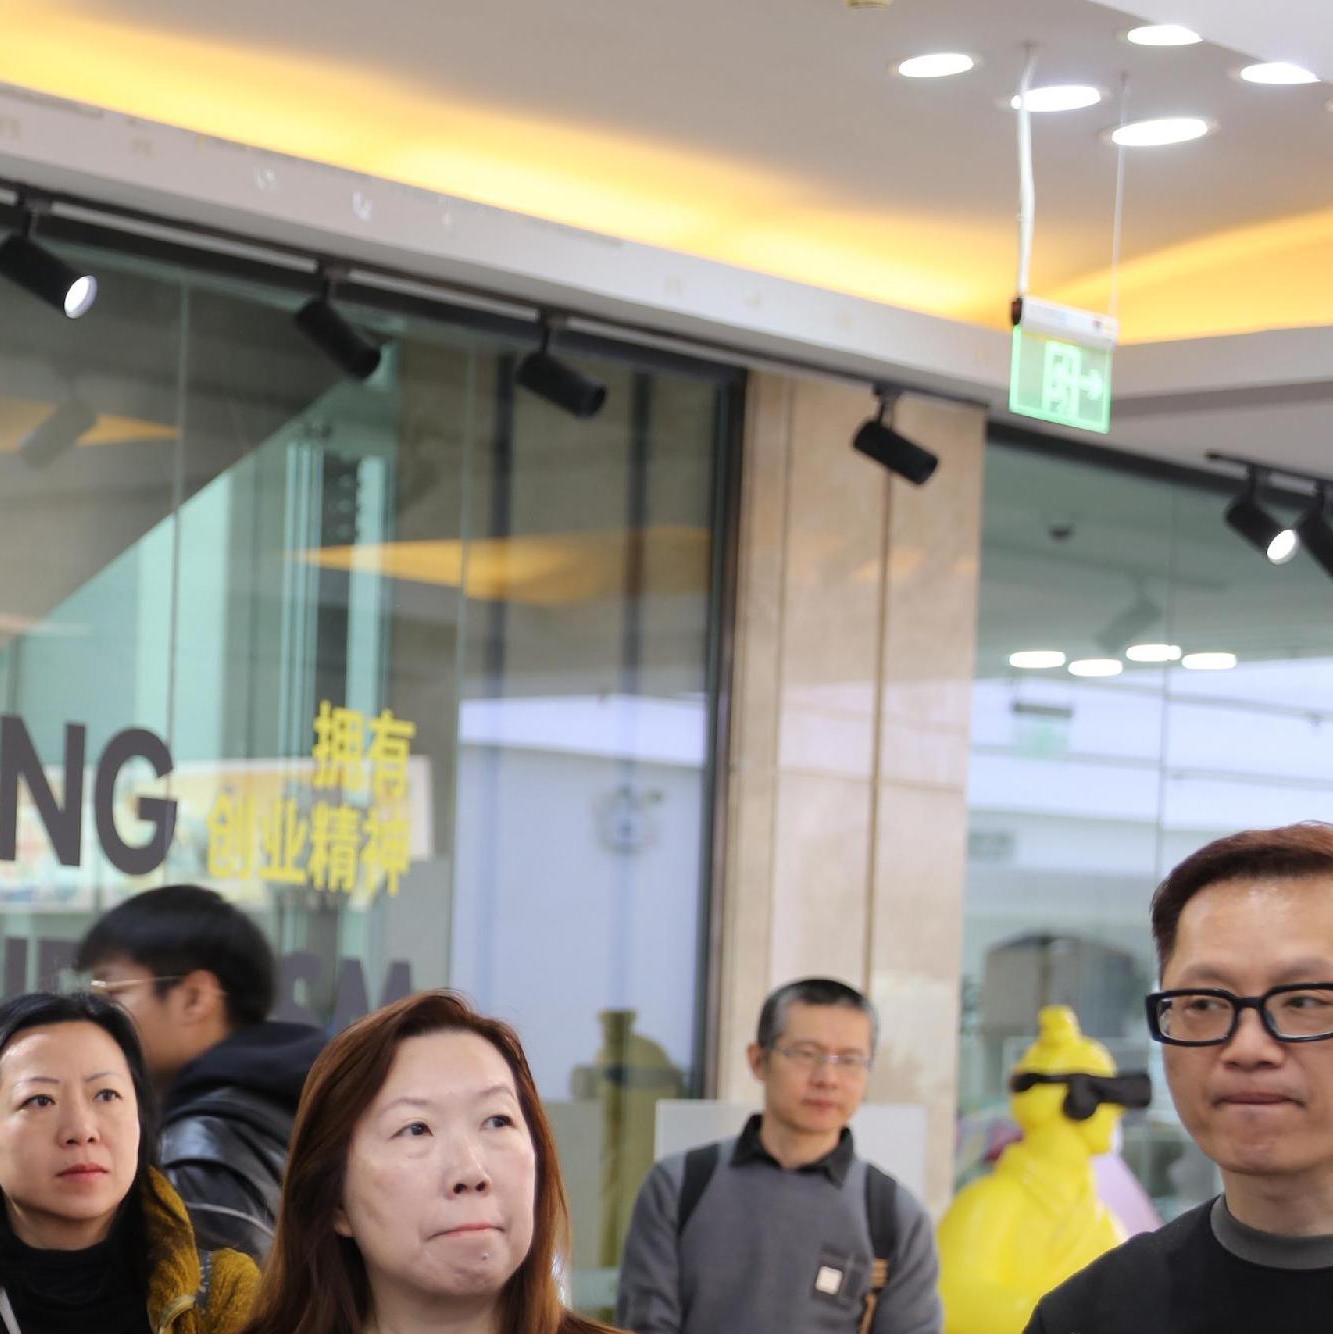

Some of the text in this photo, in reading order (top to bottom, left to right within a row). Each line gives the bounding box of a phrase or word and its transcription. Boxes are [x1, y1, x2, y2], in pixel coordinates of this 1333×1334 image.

[312, 699, 417, 791] 拥有
[206, 793, 412, 896] 创业精神
